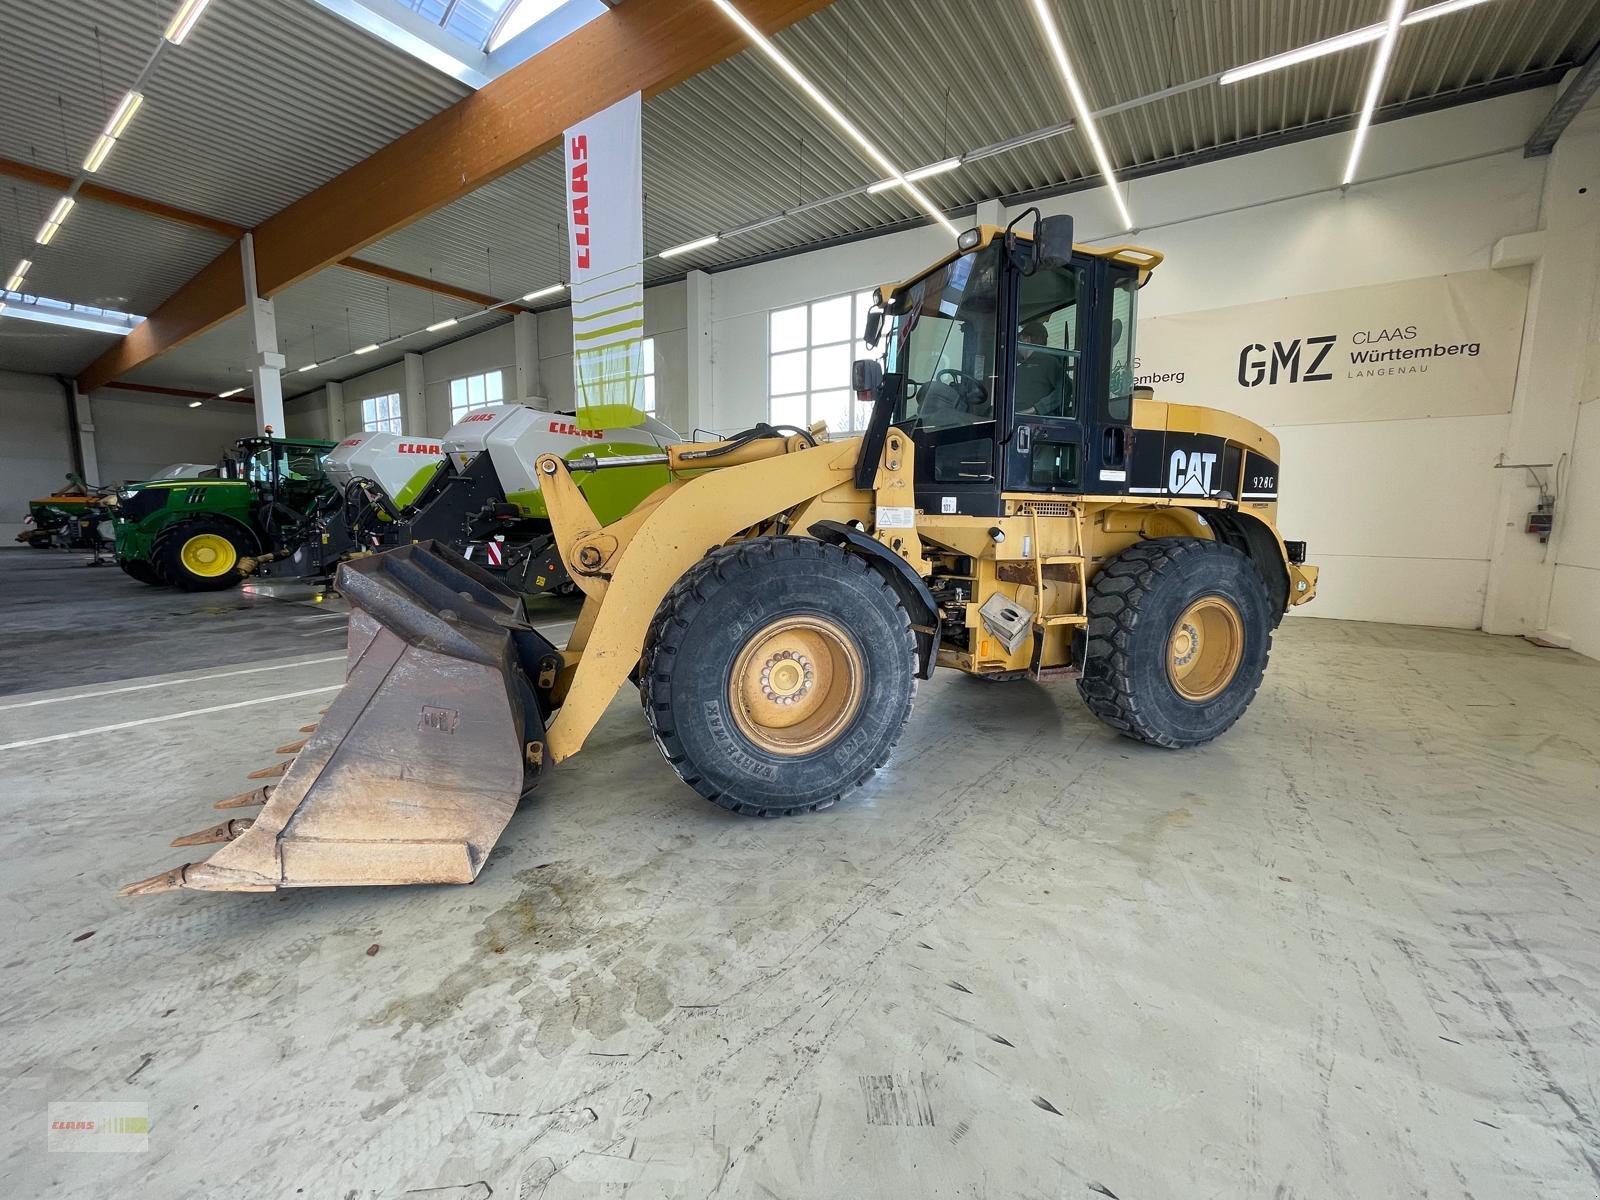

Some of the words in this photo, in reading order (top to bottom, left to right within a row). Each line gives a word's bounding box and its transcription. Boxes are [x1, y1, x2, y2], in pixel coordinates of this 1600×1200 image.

[572, 135, 590, 268] CLAAS
[1352, 325, 1417, 345] CLAAS
[1237, 335, 1337, 388] GMZ
[1350, 342, 1480, 364] Württemberg
[1133, 372, 1185, 384] emberg
[1347, 365, 1429, 379] LANGENAU
[397, 443, 442, 455] CLAA
[1168, 449, 1217, 497] CAT
[1253, 476, 1274, 489] 928G
